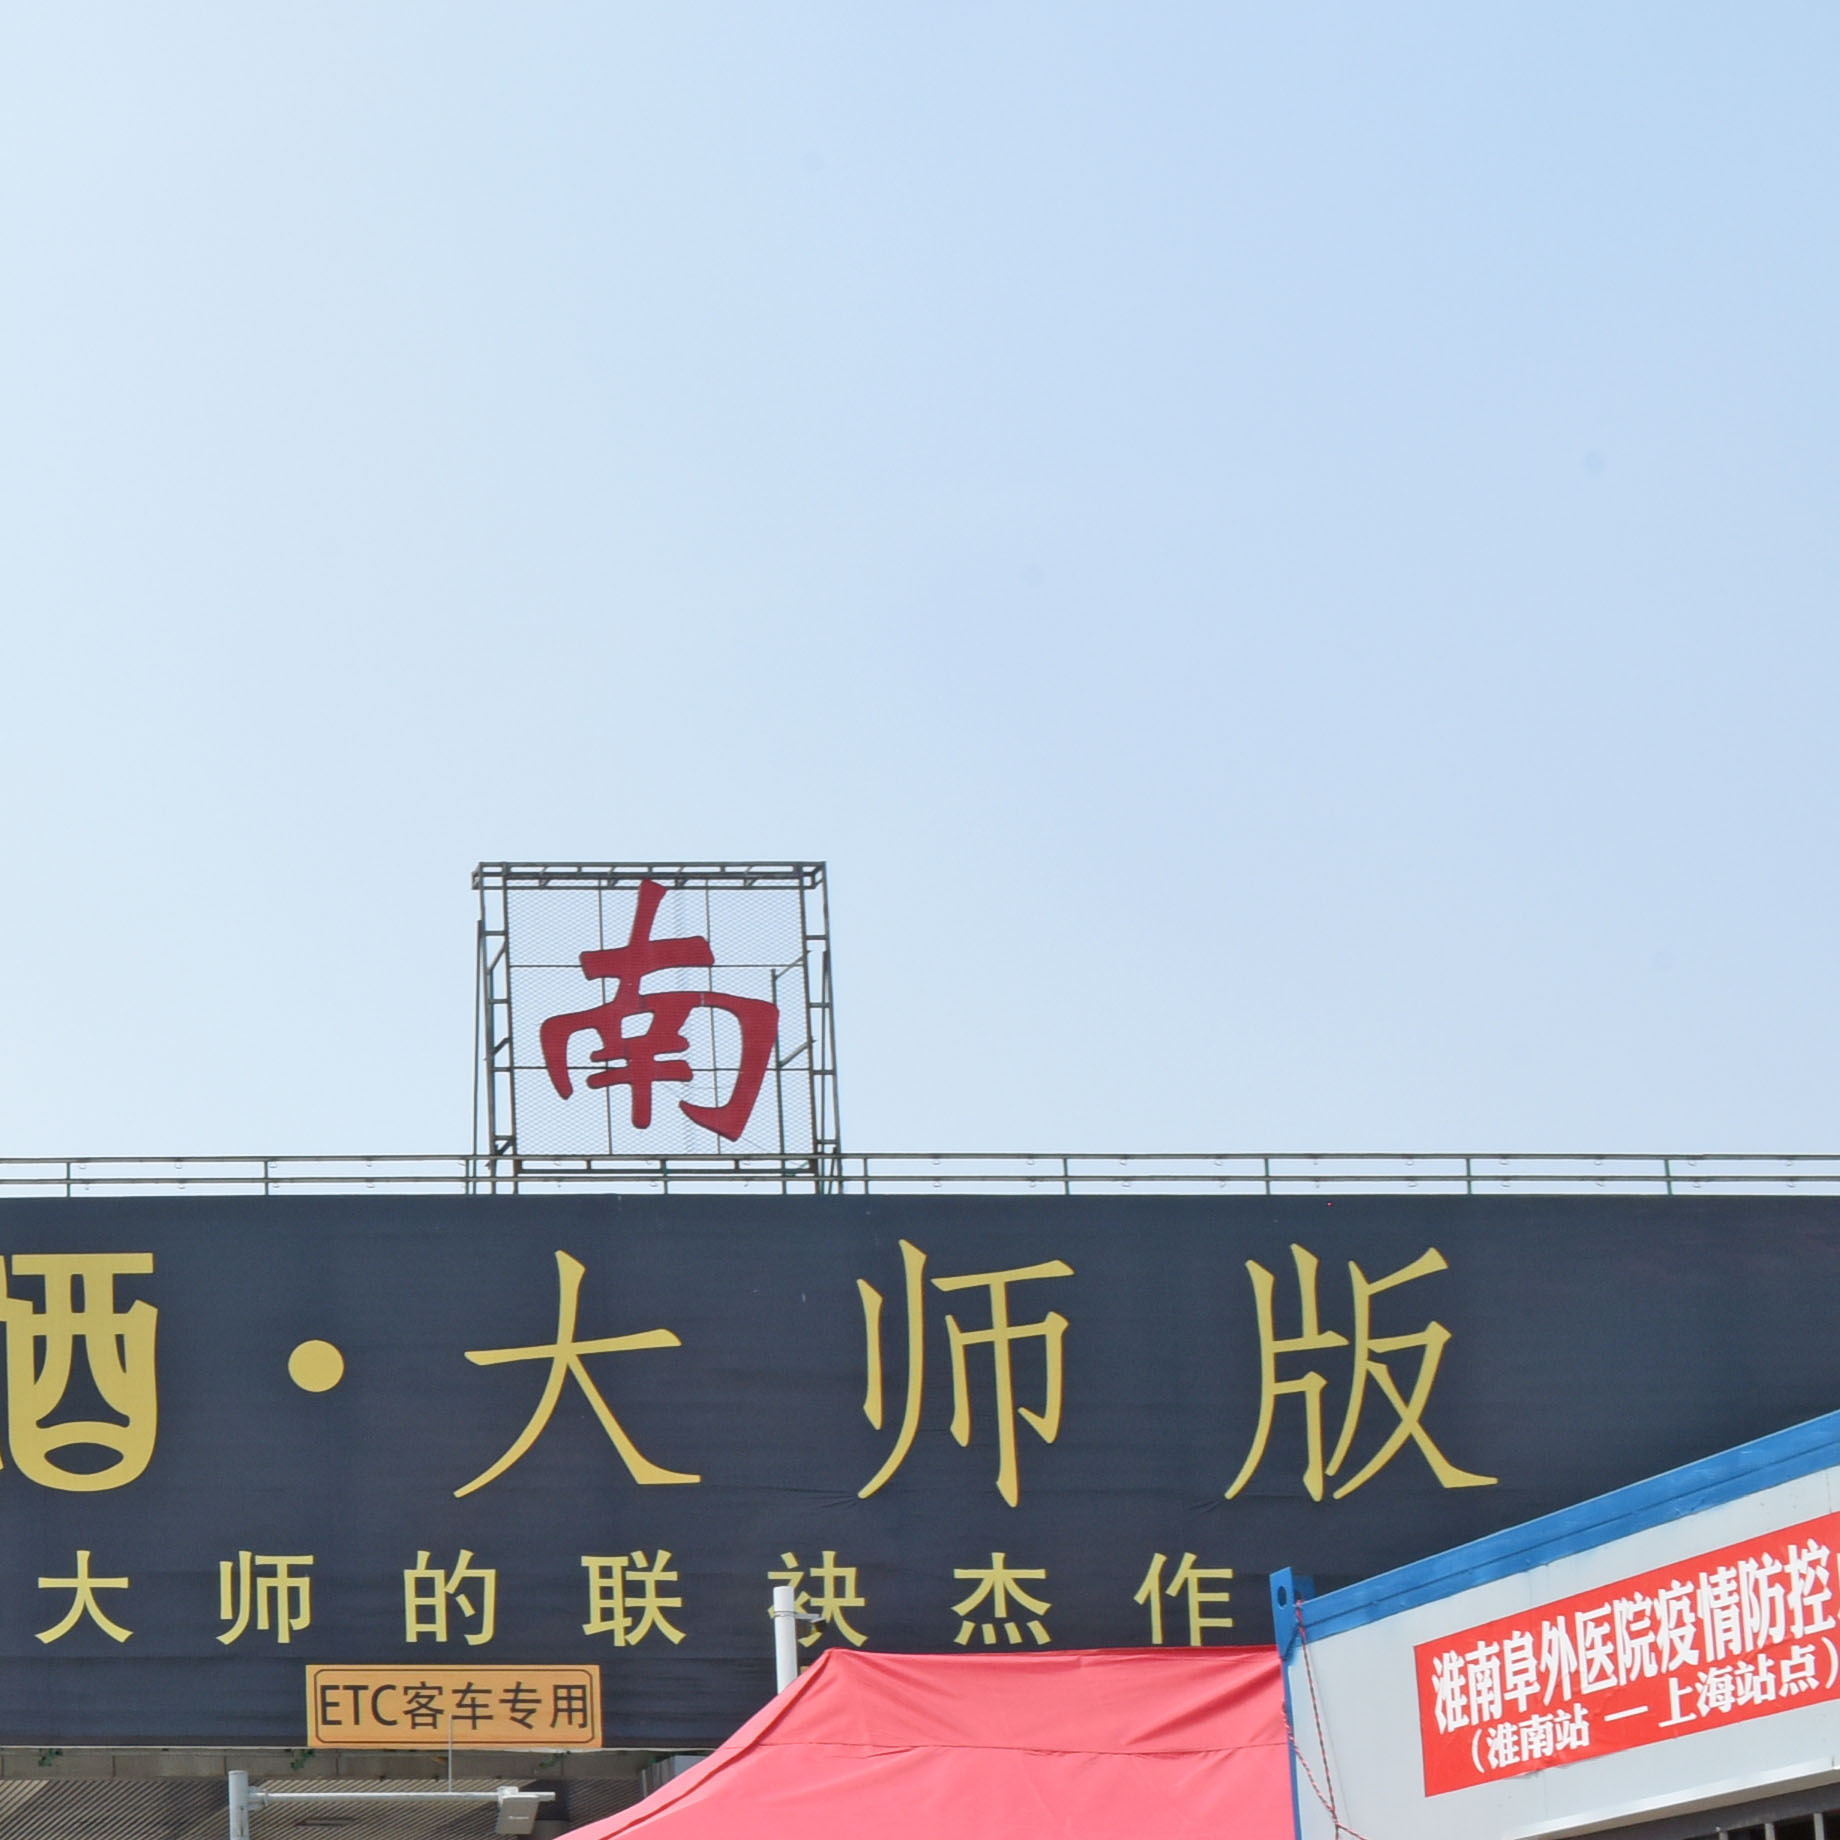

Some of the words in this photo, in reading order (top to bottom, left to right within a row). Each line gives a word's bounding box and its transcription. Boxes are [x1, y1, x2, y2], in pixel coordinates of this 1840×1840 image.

[539, 878, 780, 1142] 南
[319, 1680, 589, 1731] ETC客车专用
[1431, 1536, 1840, 1735] 淮南阜外医院疫情防控
